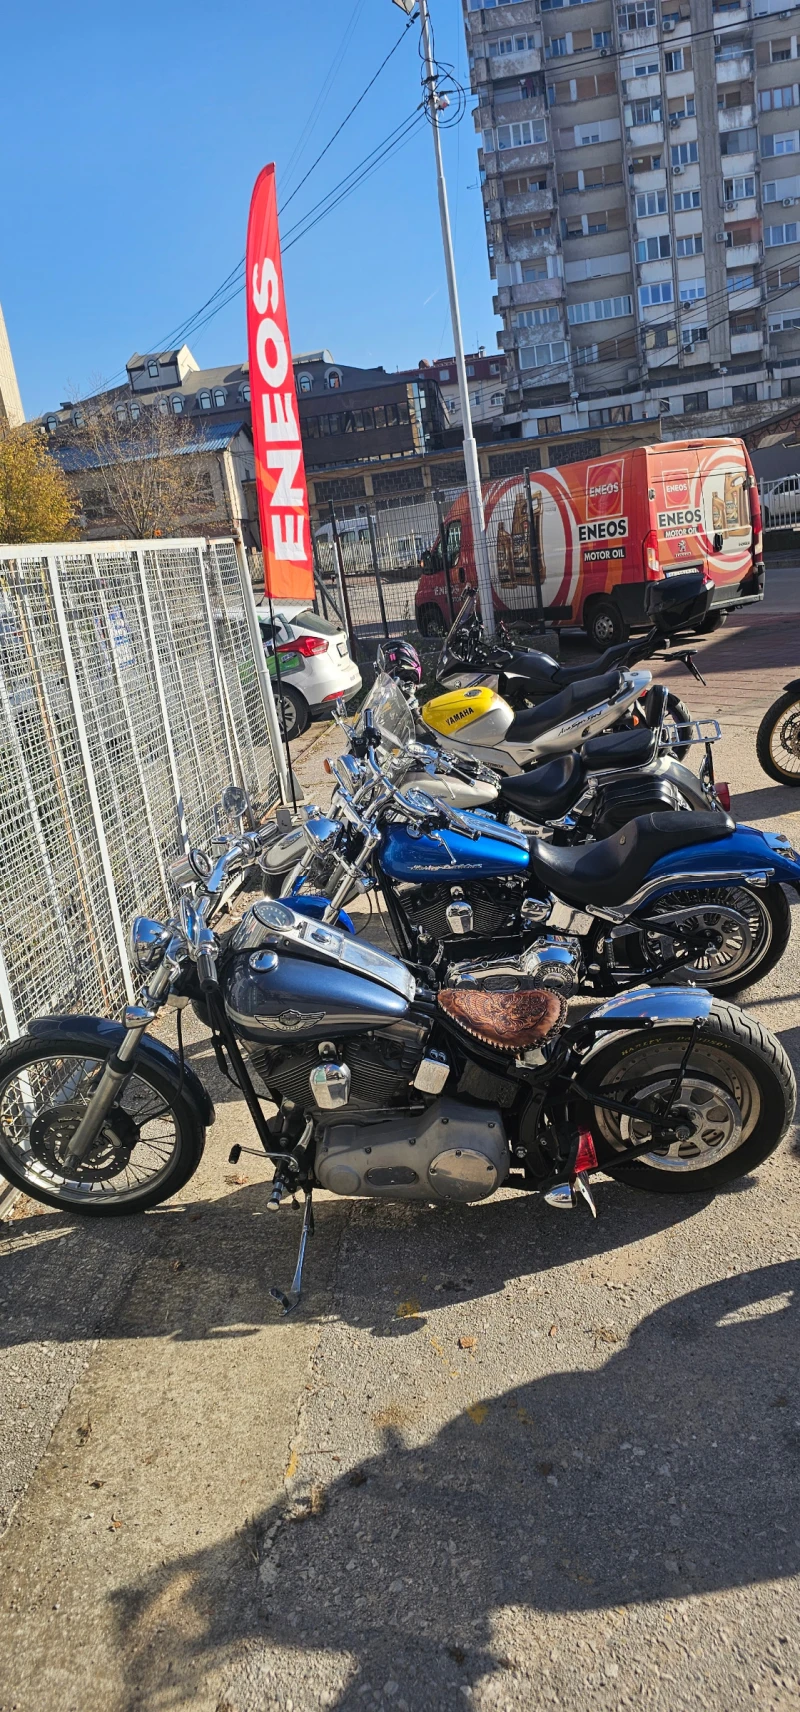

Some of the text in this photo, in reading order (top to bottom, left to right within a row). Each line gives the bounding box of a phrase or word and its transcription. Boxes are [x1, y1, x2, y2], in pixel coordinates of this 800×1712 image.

[252, 257, 308, 561] ENEOS
[589, 482, 619, 497] ENEOS
[666, 484, 687, 493] ENEOS
[658, 509, 702, 527] ENEOS
[578, 519, 627, 541] ENEOS
[665, 529, 686, 538] MOTOR
[584, 549, 625, 561] MOTOR OIL
[446, 707, 474, 726] YAMAHA
